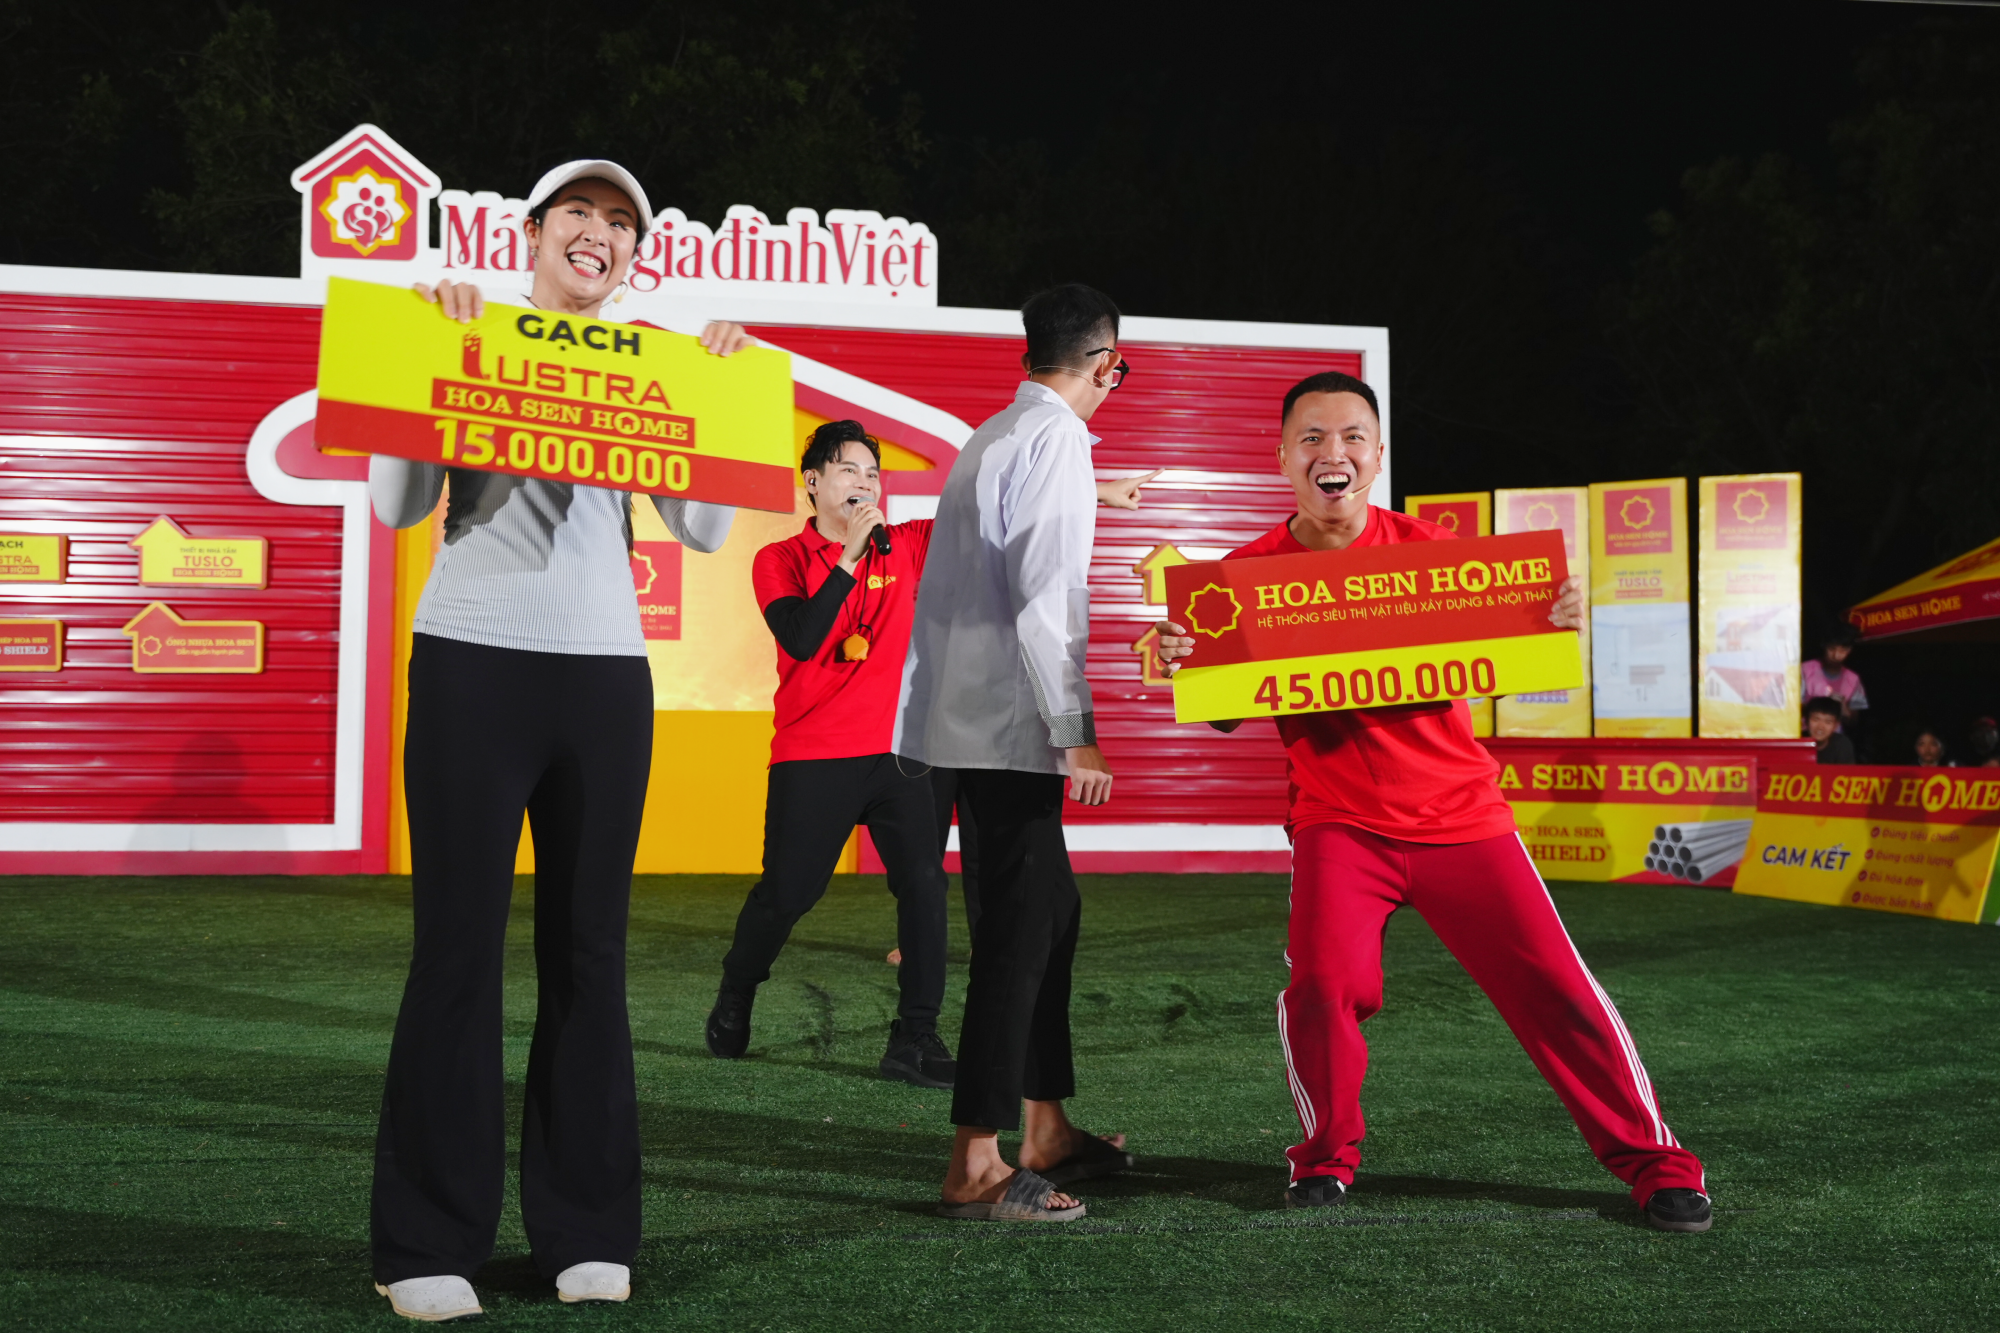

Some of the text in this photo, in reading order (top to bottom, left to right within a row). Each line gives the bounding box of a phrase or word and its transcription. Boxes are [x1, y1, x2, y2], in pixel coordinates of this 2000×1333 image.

[629, 221, 705, 292] gia
[711, 216, 829, 285] đình
[828, 222, 931, 297] Việt
[516, 314, 641, 356] GẠCH
[462, 328, 673, 410] LUSTRA
[444, 385, 689, 441] HOA SEN HOME
[434, 417, 691, 492] 15.000.000
[175, 568, 241, 577] HOA SEN HOME
[183, 555, 234, 567] TUSLO
[1254, 557, 1552, 610] HOA SEN HOME
[1618, 576, 1661, 588] TUSLO
[638, 604, 677, 616] HOME
[1257, 586, 1553, 629] HỆ THỐNG SIÊU THỊ VẬT LIỆU XÂY DỰNG & NỘI THẤT
[1867, 609, 1892, 627] HOA
[1894, 603, 1918, 621] SEN
[1919, 595, 1961, 616] HOME
[3, 645, 49, 655] SHIELD
[32, 636, 48, 644] SEN
[166, 635, 187, 647] ỐNG
[215, 638, 236, 647] HOA
[236, 638, 255, 647] SEN
[1254, 657, 1496, 711] 45.000.000
[1532, 763, 1608, 790] SEN
[1617, 761, 1748, 796] HOME
[1764, 774, 2000, 812] HOA SEN HOME
[1537, 825, 1570, 837] HOA
[1573, 826, 1605, 838] SEN
[1526, 844, 1606, 862] HIELD
[1762, 843, 1851, 871] CAM KẾT
